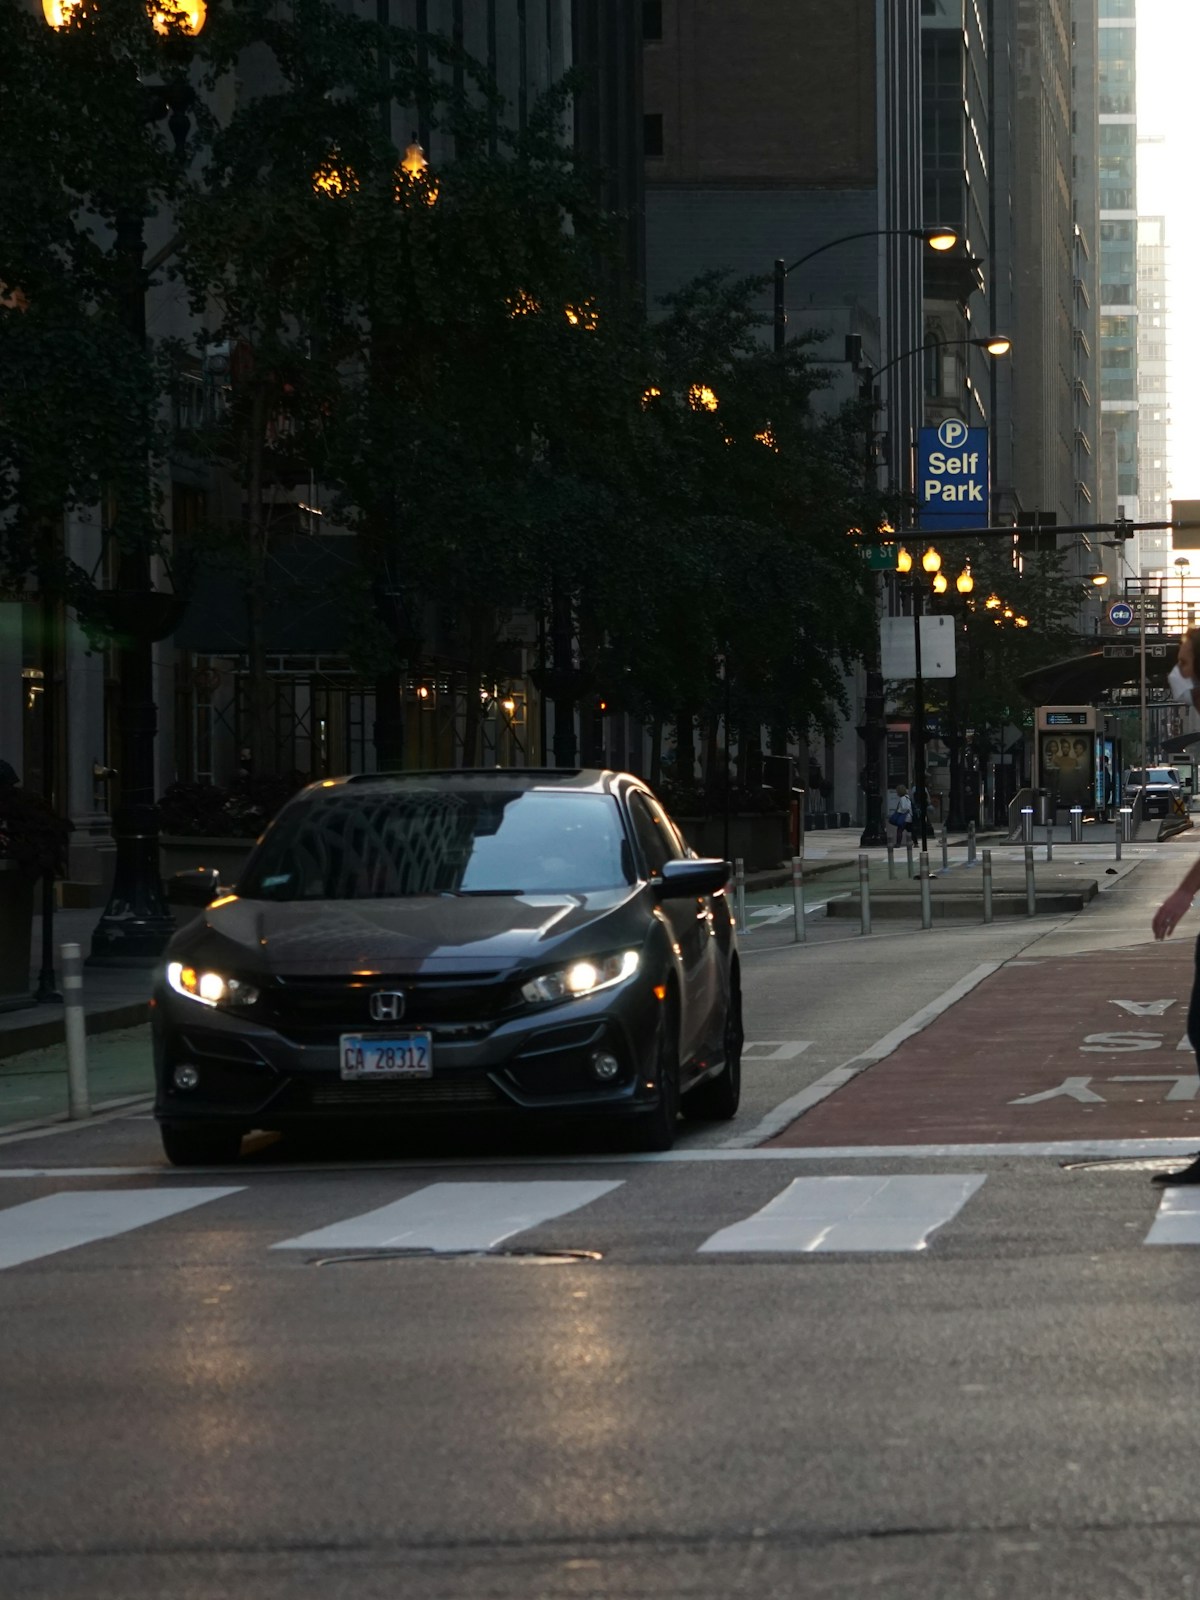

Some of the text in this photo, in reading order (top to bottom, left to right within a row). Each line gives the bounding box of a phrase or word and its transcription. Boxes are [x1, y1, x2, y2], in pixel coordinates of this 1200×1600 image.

[946, 423, 962, 444] P
[929, 452, 979, 475] Self
[925, 480, 983, 502] Park
[880, 545, 893, 558] St
[1112, 610, 1130, 619] cta
[344, 1047, 427, 1071] CA 28312
